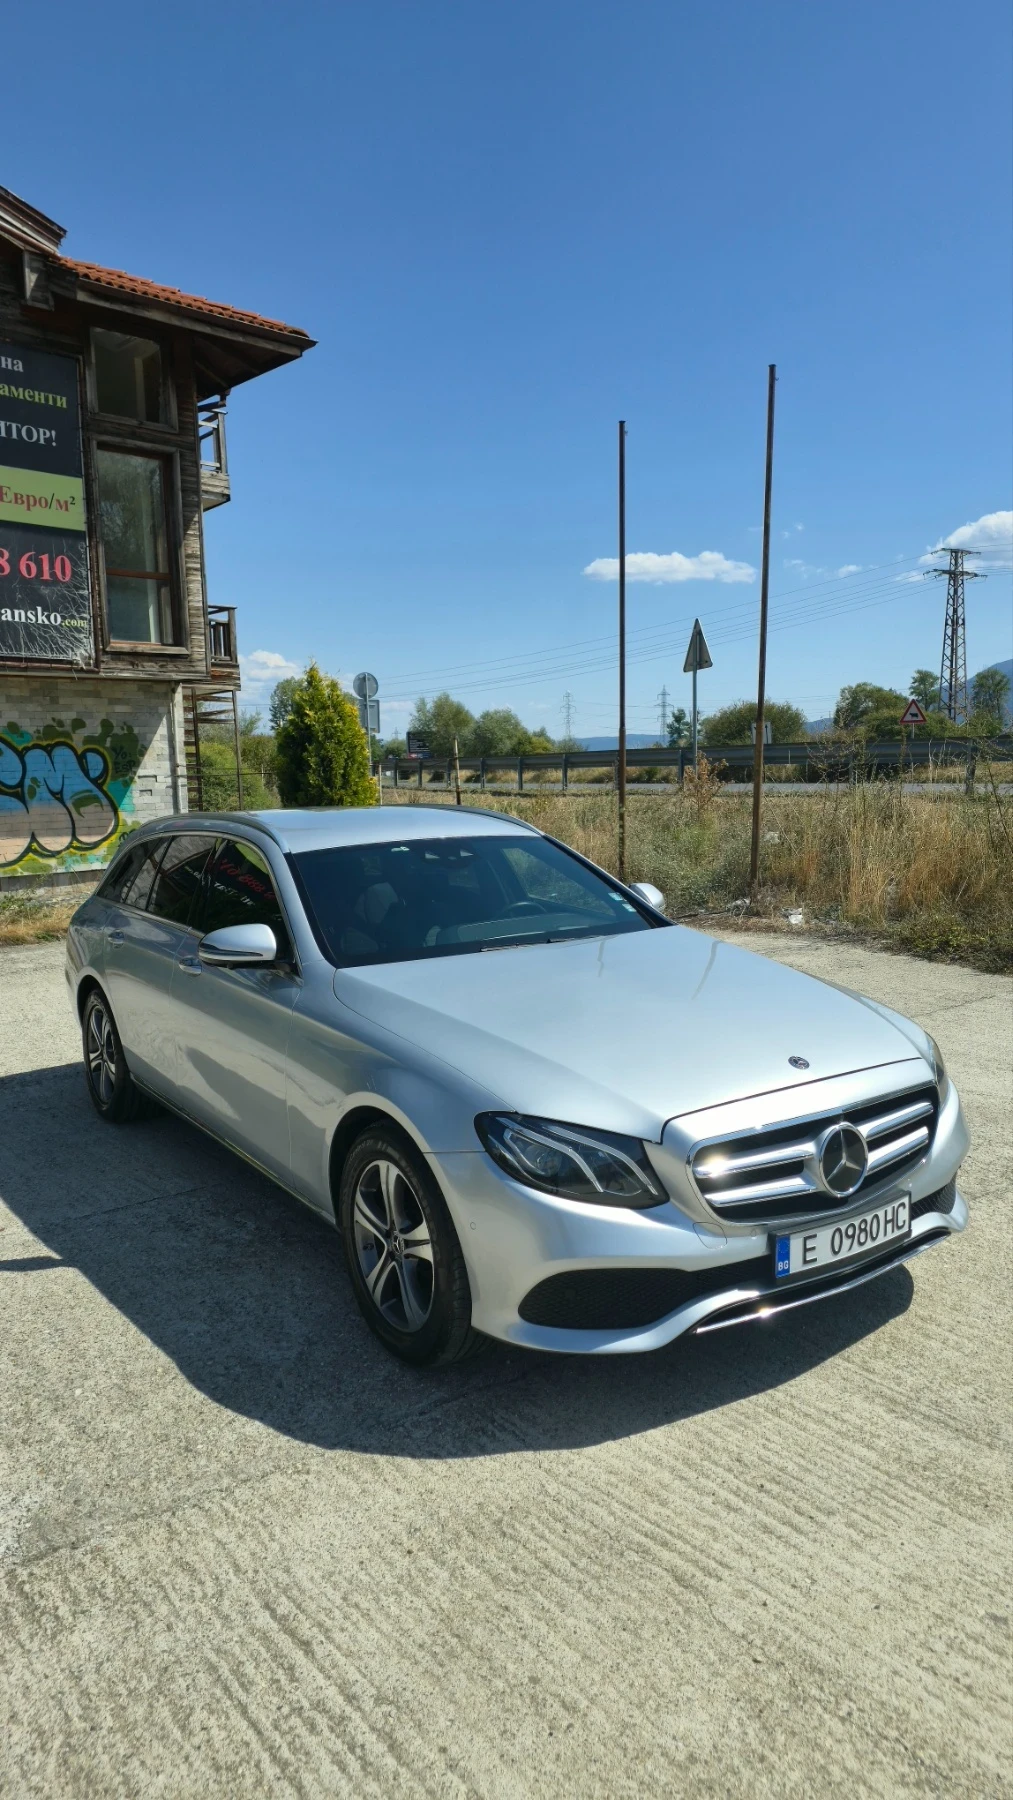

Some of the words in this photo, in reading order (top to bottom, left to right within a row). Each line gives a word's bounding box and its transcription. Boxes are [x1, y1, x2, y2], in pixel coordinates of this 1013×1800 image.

[1, 356, 24, 372] на
[19, 551, 72, 582] 610
[803, 1233, 818, 1265] E
[831, 1213, 880, 1256] 0980
[883, 1202, 906, 1237] HC
[778, 1261, 789, 1271] BG
